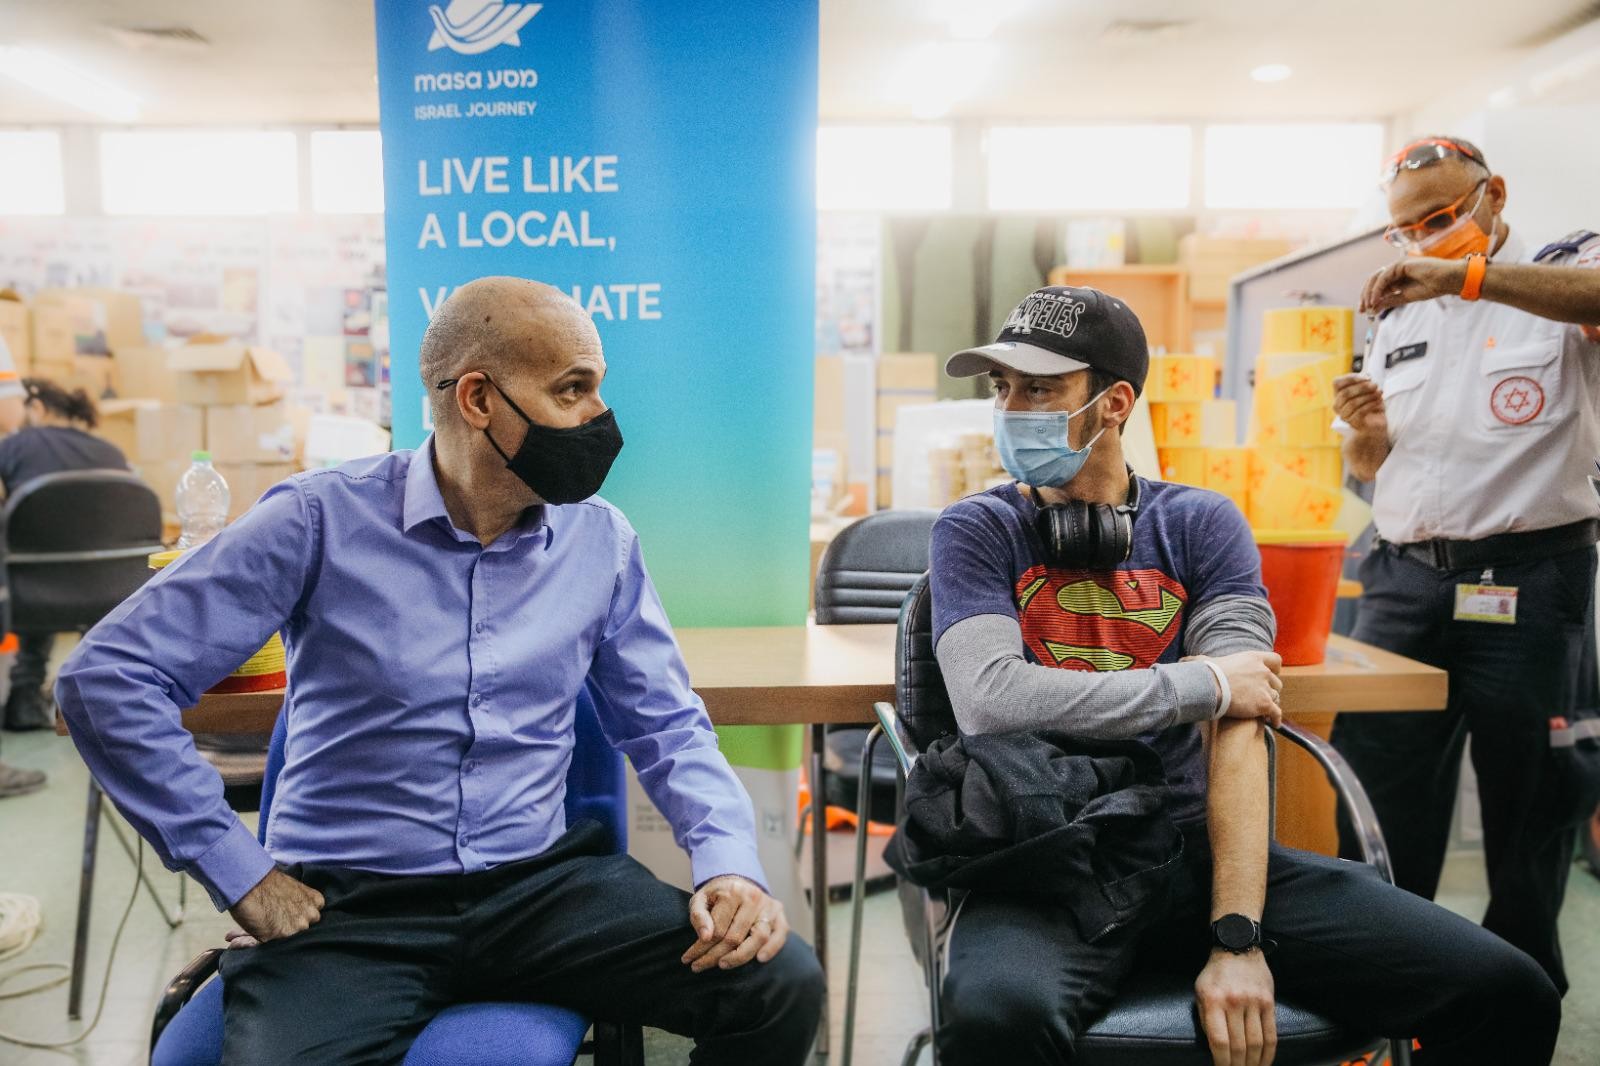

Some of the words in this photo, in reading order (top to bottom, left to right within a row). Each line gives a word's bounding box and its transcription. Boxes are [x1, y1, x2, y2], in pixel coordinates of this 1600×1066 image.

[414, 70, 483, 93] masa
[486, 68, 539, 90] מסע
[414, 103, 462, 121] ISRAEL
[465, 101, 537, 117] JOURNEY
[418, 156, 510, 196] LIVE
[522, 154, 619, 194] LIKE
[417, 213, 447, 249] A
[457, 210, 617, 252] LOCAL,
